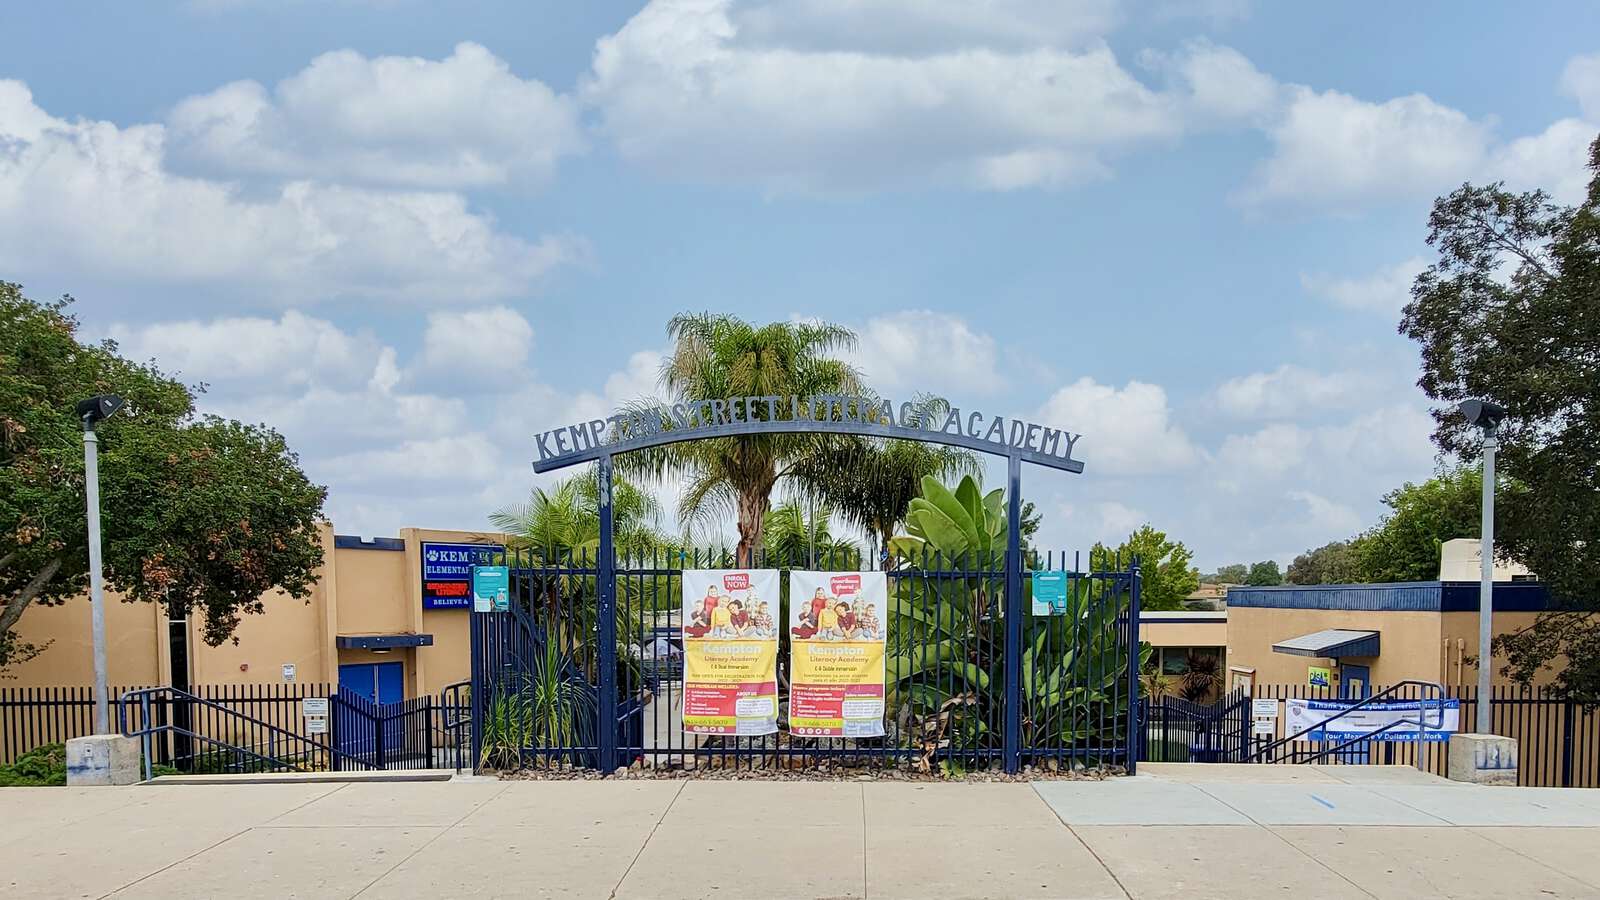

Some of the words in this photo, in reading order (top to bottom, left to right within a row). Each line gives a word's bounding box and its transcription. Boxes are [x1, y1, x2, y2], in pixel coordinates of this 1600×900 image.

[672, 395, 781, 428] STREET
[942, 407, 1082, 460] ACADEMY
[727, 581, 747, 589] NOW
[703, 643, 762, 655] Kempton
[808, 644, 865, 656] Kempton
[730, 655, 759, 663] Academy
[1387, 703, 1421, 711] generous
